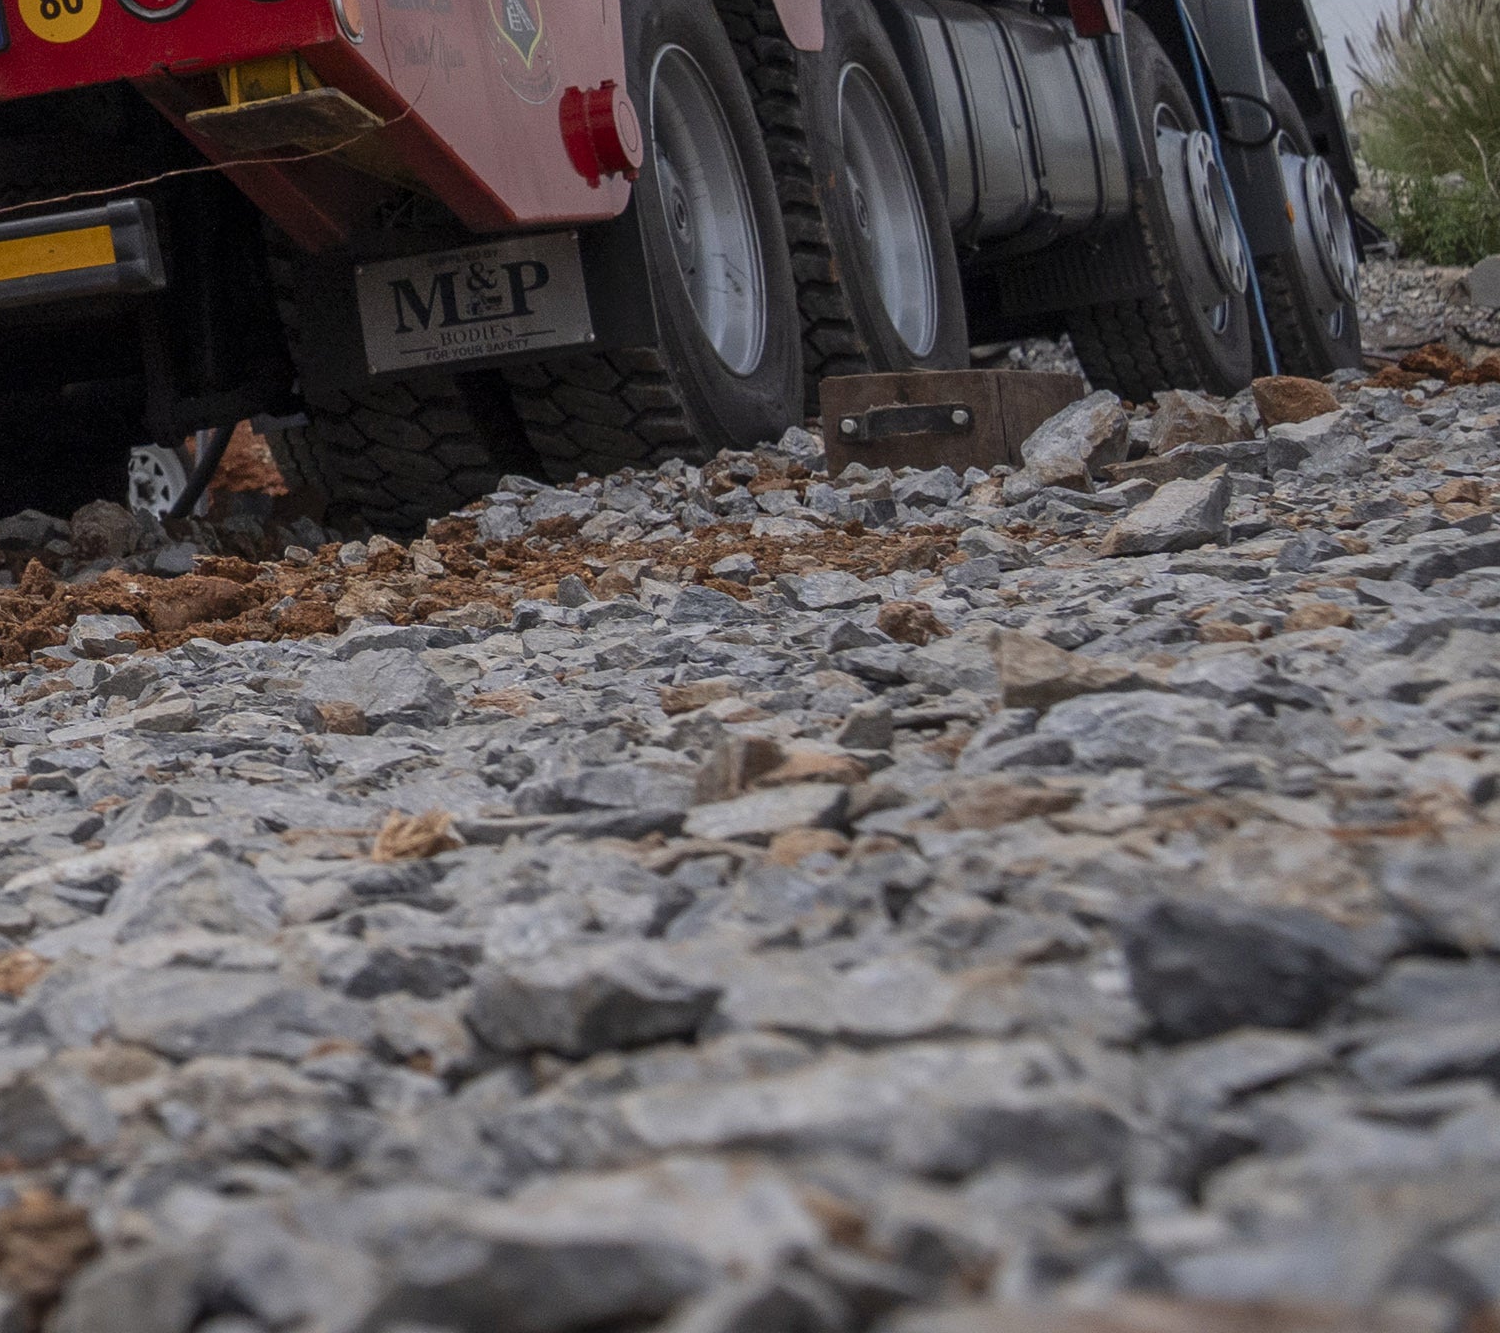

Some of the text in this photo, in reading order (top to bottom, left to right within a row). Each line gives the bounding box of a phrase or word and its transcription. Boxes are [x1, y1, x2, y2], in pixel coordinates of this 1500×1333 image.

[388, 260, 550, 334] M&P
[440, 325, 514, 348] BODIES
[425, 338, 529, 361] FOR YOUR SAFETY
